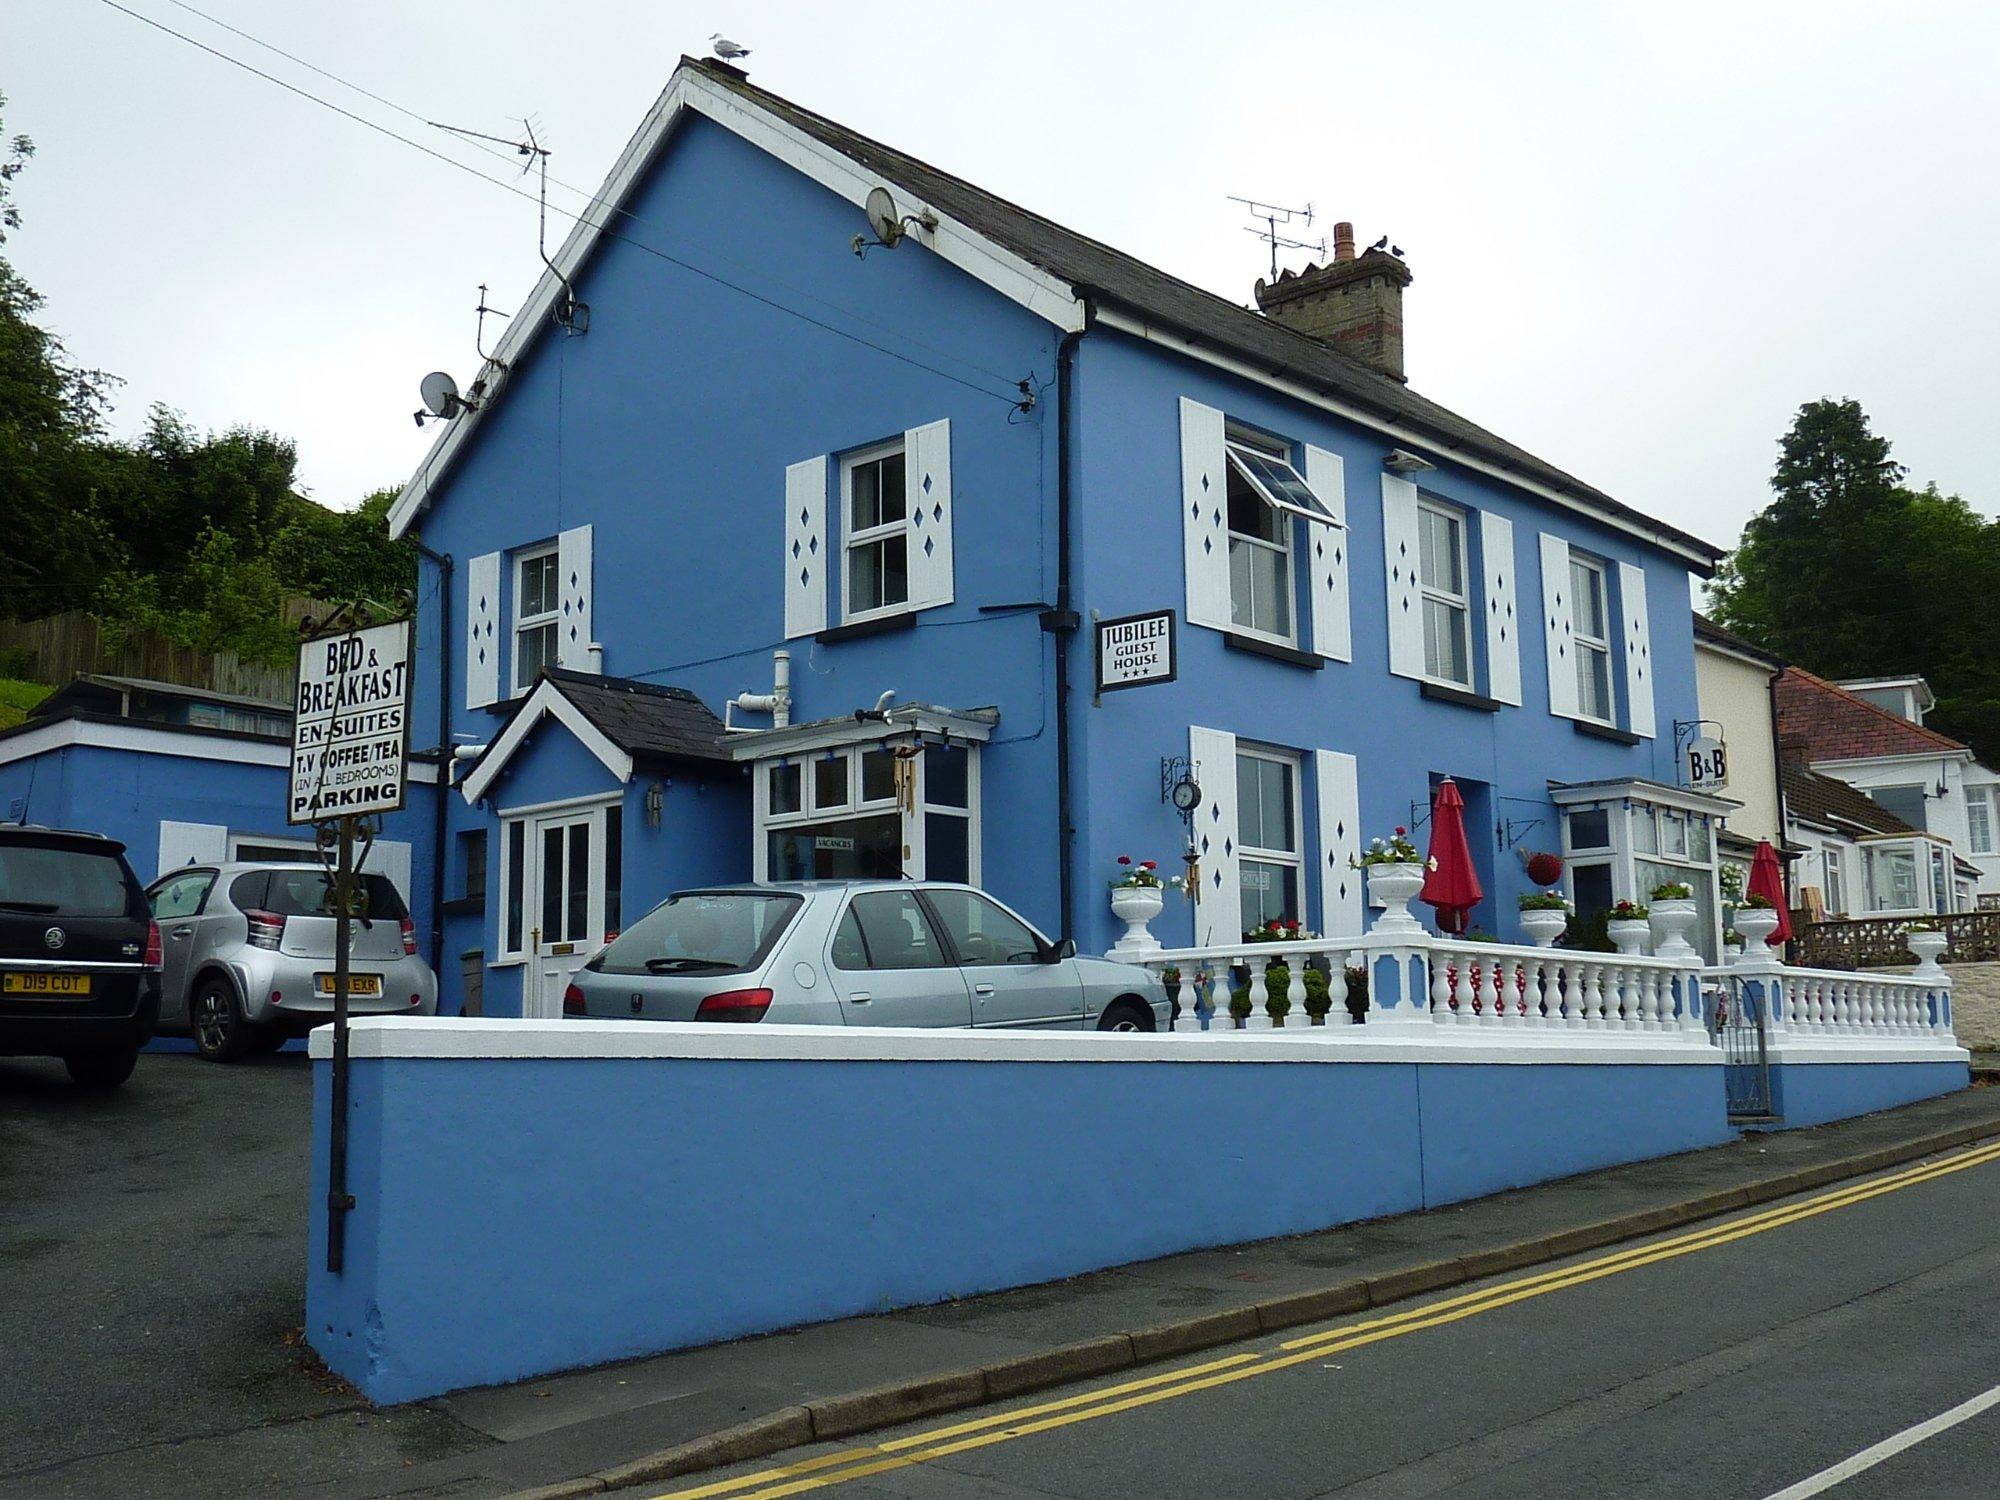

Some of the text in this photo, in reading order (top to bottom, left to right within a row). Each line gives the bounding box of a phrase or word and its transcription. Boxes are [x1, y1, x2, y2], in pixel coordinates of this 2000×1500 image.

[1106, 620, 1165, 649] JUBILEE
[326, 636, 379, 676] BED &
[1116, 641, 1156, 656] GUEST
[1114, 654, 1158, 670] HOUSE
[299, 661, 405, 715] BREAKFAST
[299, 710, 400, 744] EN-SUITES
[315, 776, 331, 787] ALL
[336, 764, 398, 785] BEDROOMS)
[295, 783, 397, 812] PARKING
[818, 839, 851, 847] VACANCIES
[353, 979, 375, 990] EXR
